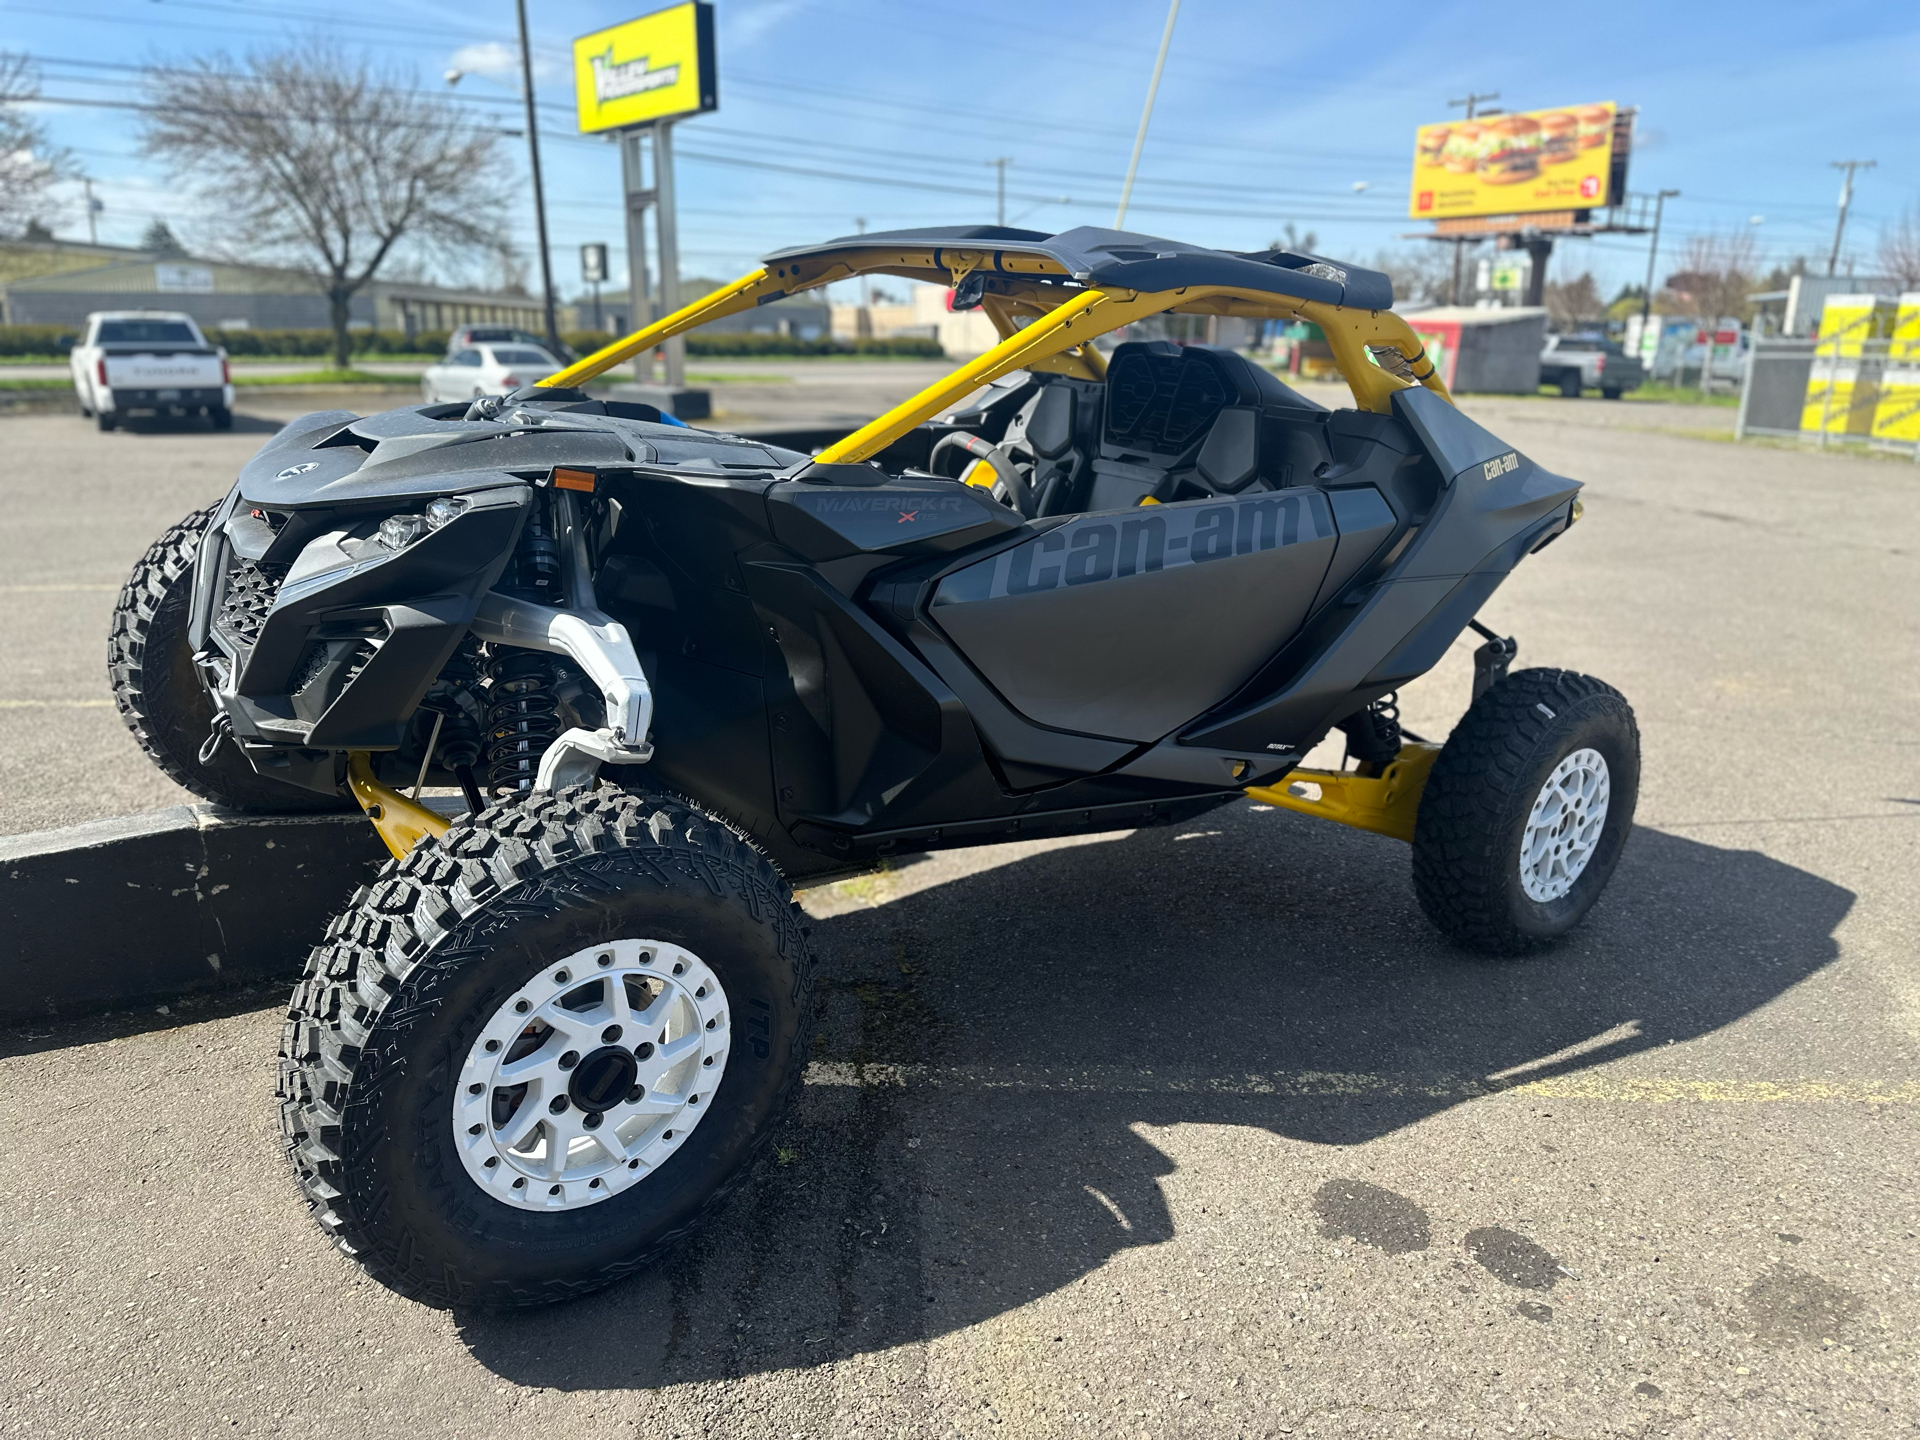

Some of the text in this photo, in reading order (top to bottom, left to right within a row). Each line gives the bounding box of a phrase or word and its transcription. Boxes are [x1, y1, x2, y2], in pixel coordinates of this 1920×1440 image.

[816, 496, 962, 512] MAVERICK R
[747, 997, 770, 1059] ITP
[418, 1081, 492, 1244] TENACITY
